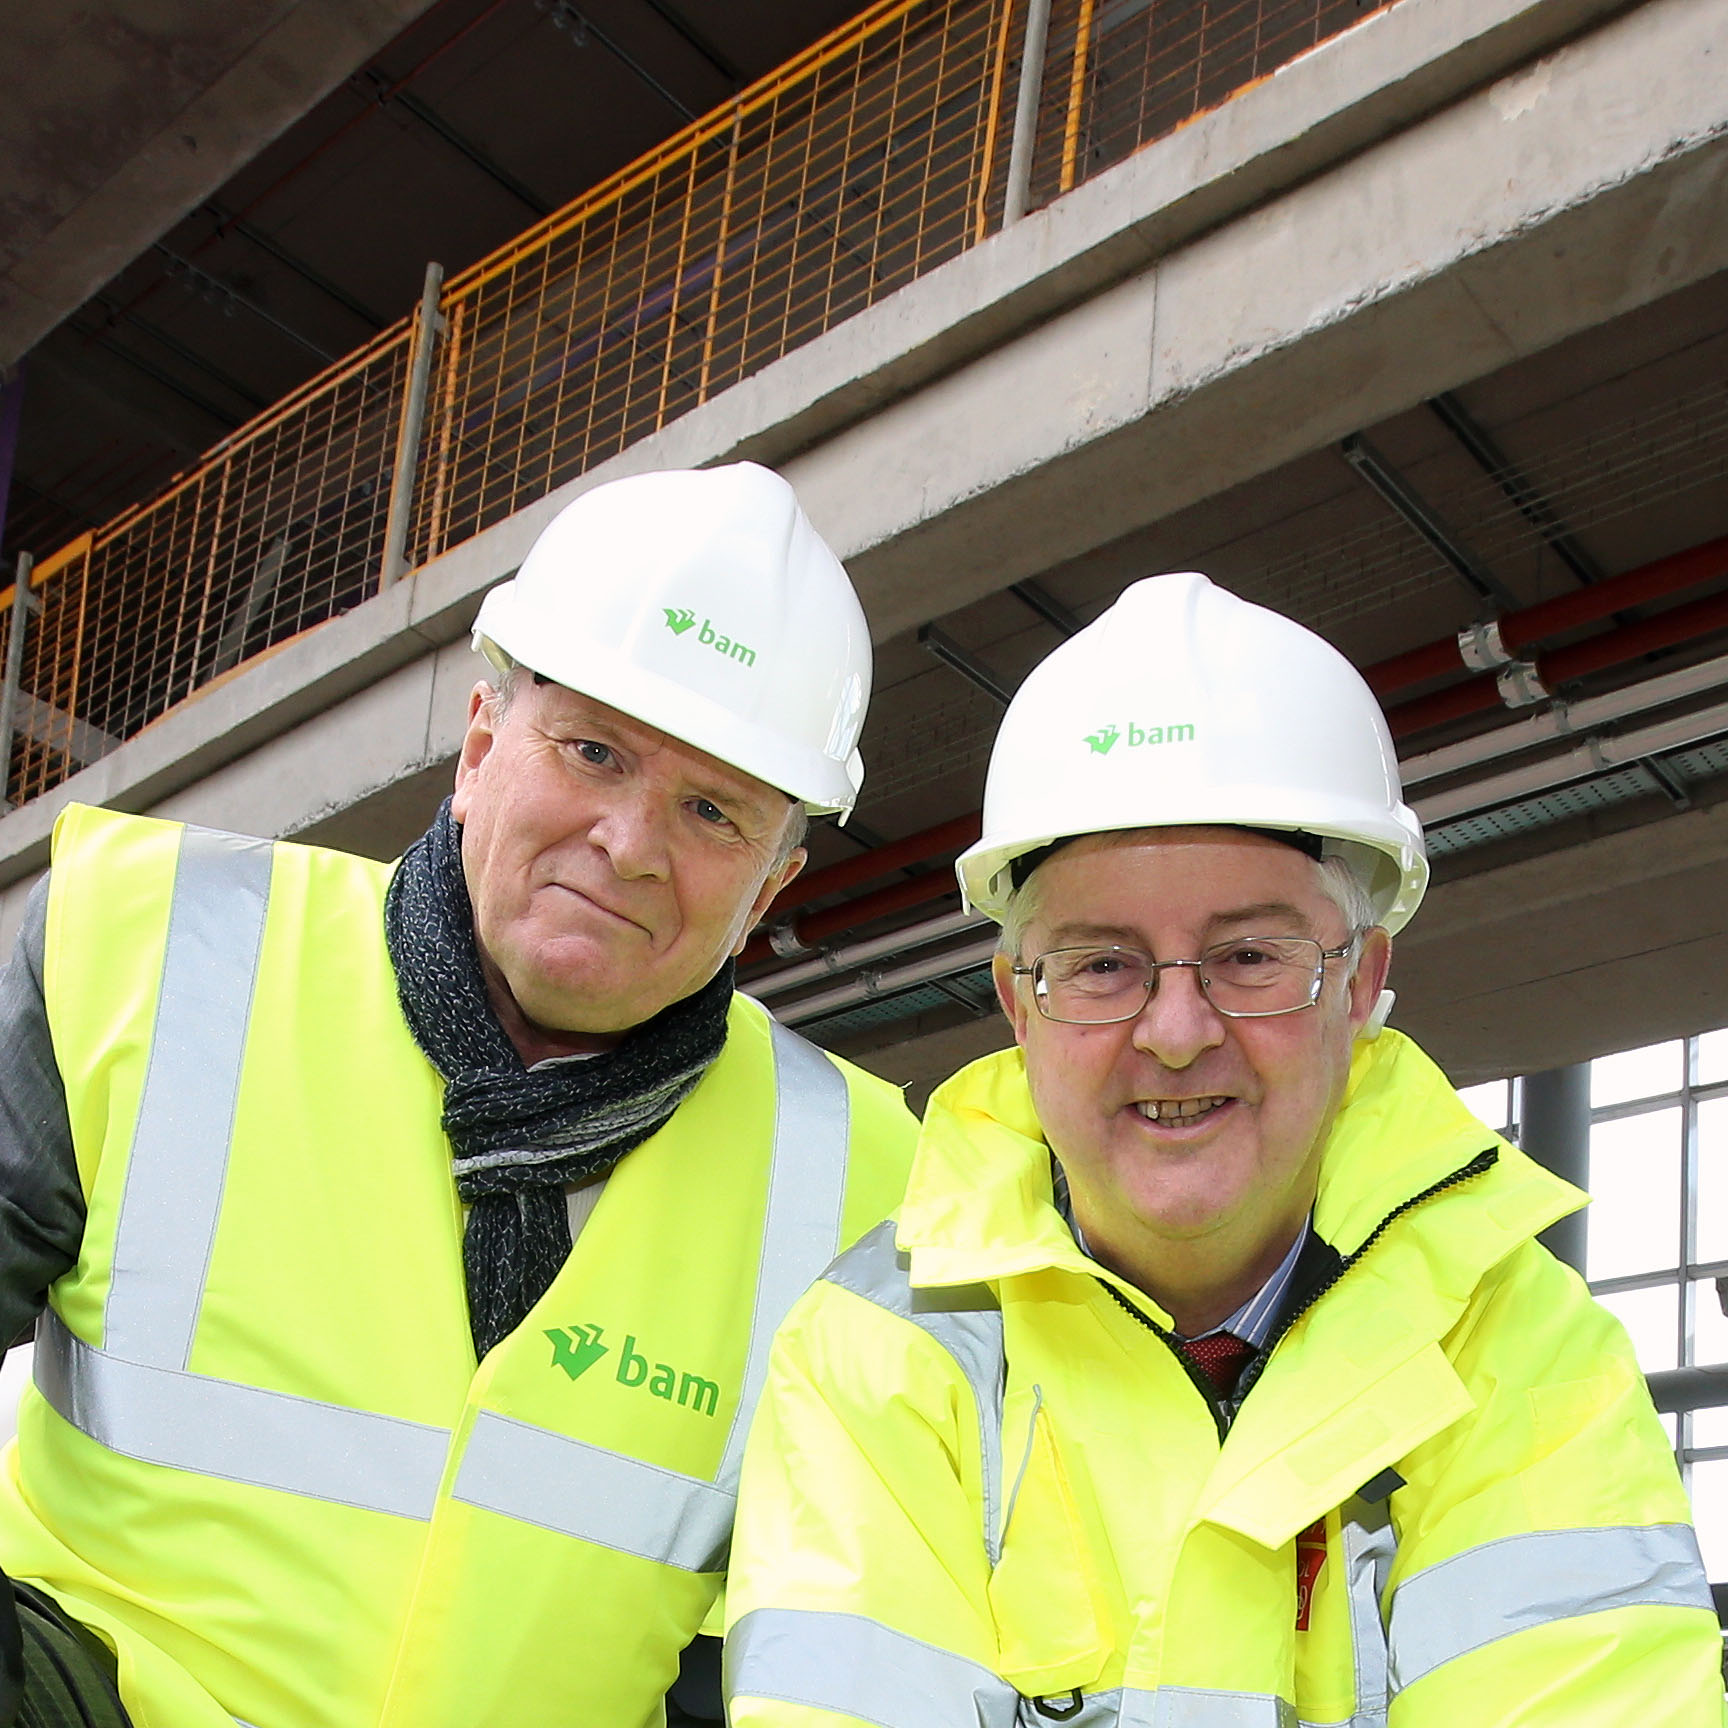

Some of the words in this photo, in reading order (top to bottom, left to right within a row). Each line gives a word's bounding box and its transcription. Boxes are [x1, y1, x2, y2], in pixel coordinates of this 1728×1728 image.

[698, 619, 756, 667] bam
[1128, 721, 1195, 747] bam
[616, 1335, 720, 1417] bam
